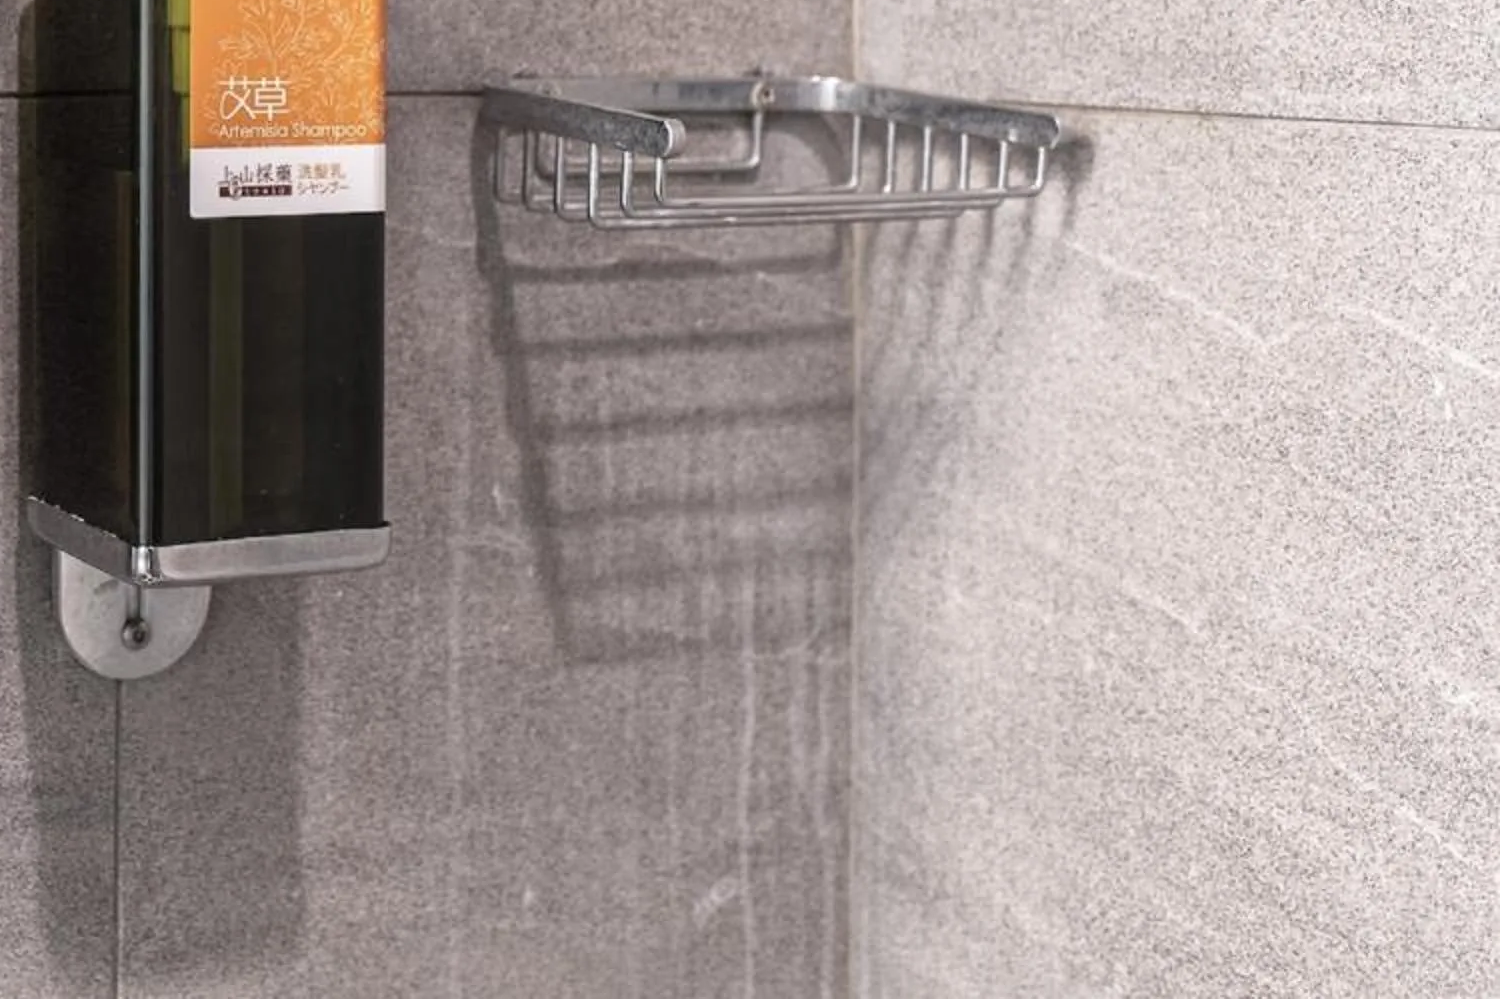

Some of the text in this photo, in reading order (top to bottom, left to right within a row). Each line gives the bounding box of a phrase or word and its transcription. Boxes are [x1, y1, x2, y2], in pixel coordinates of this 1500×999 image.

[218, 76, 292, 121] 艾草
[219, 121, 368, 142] Artemisia Shampoo
